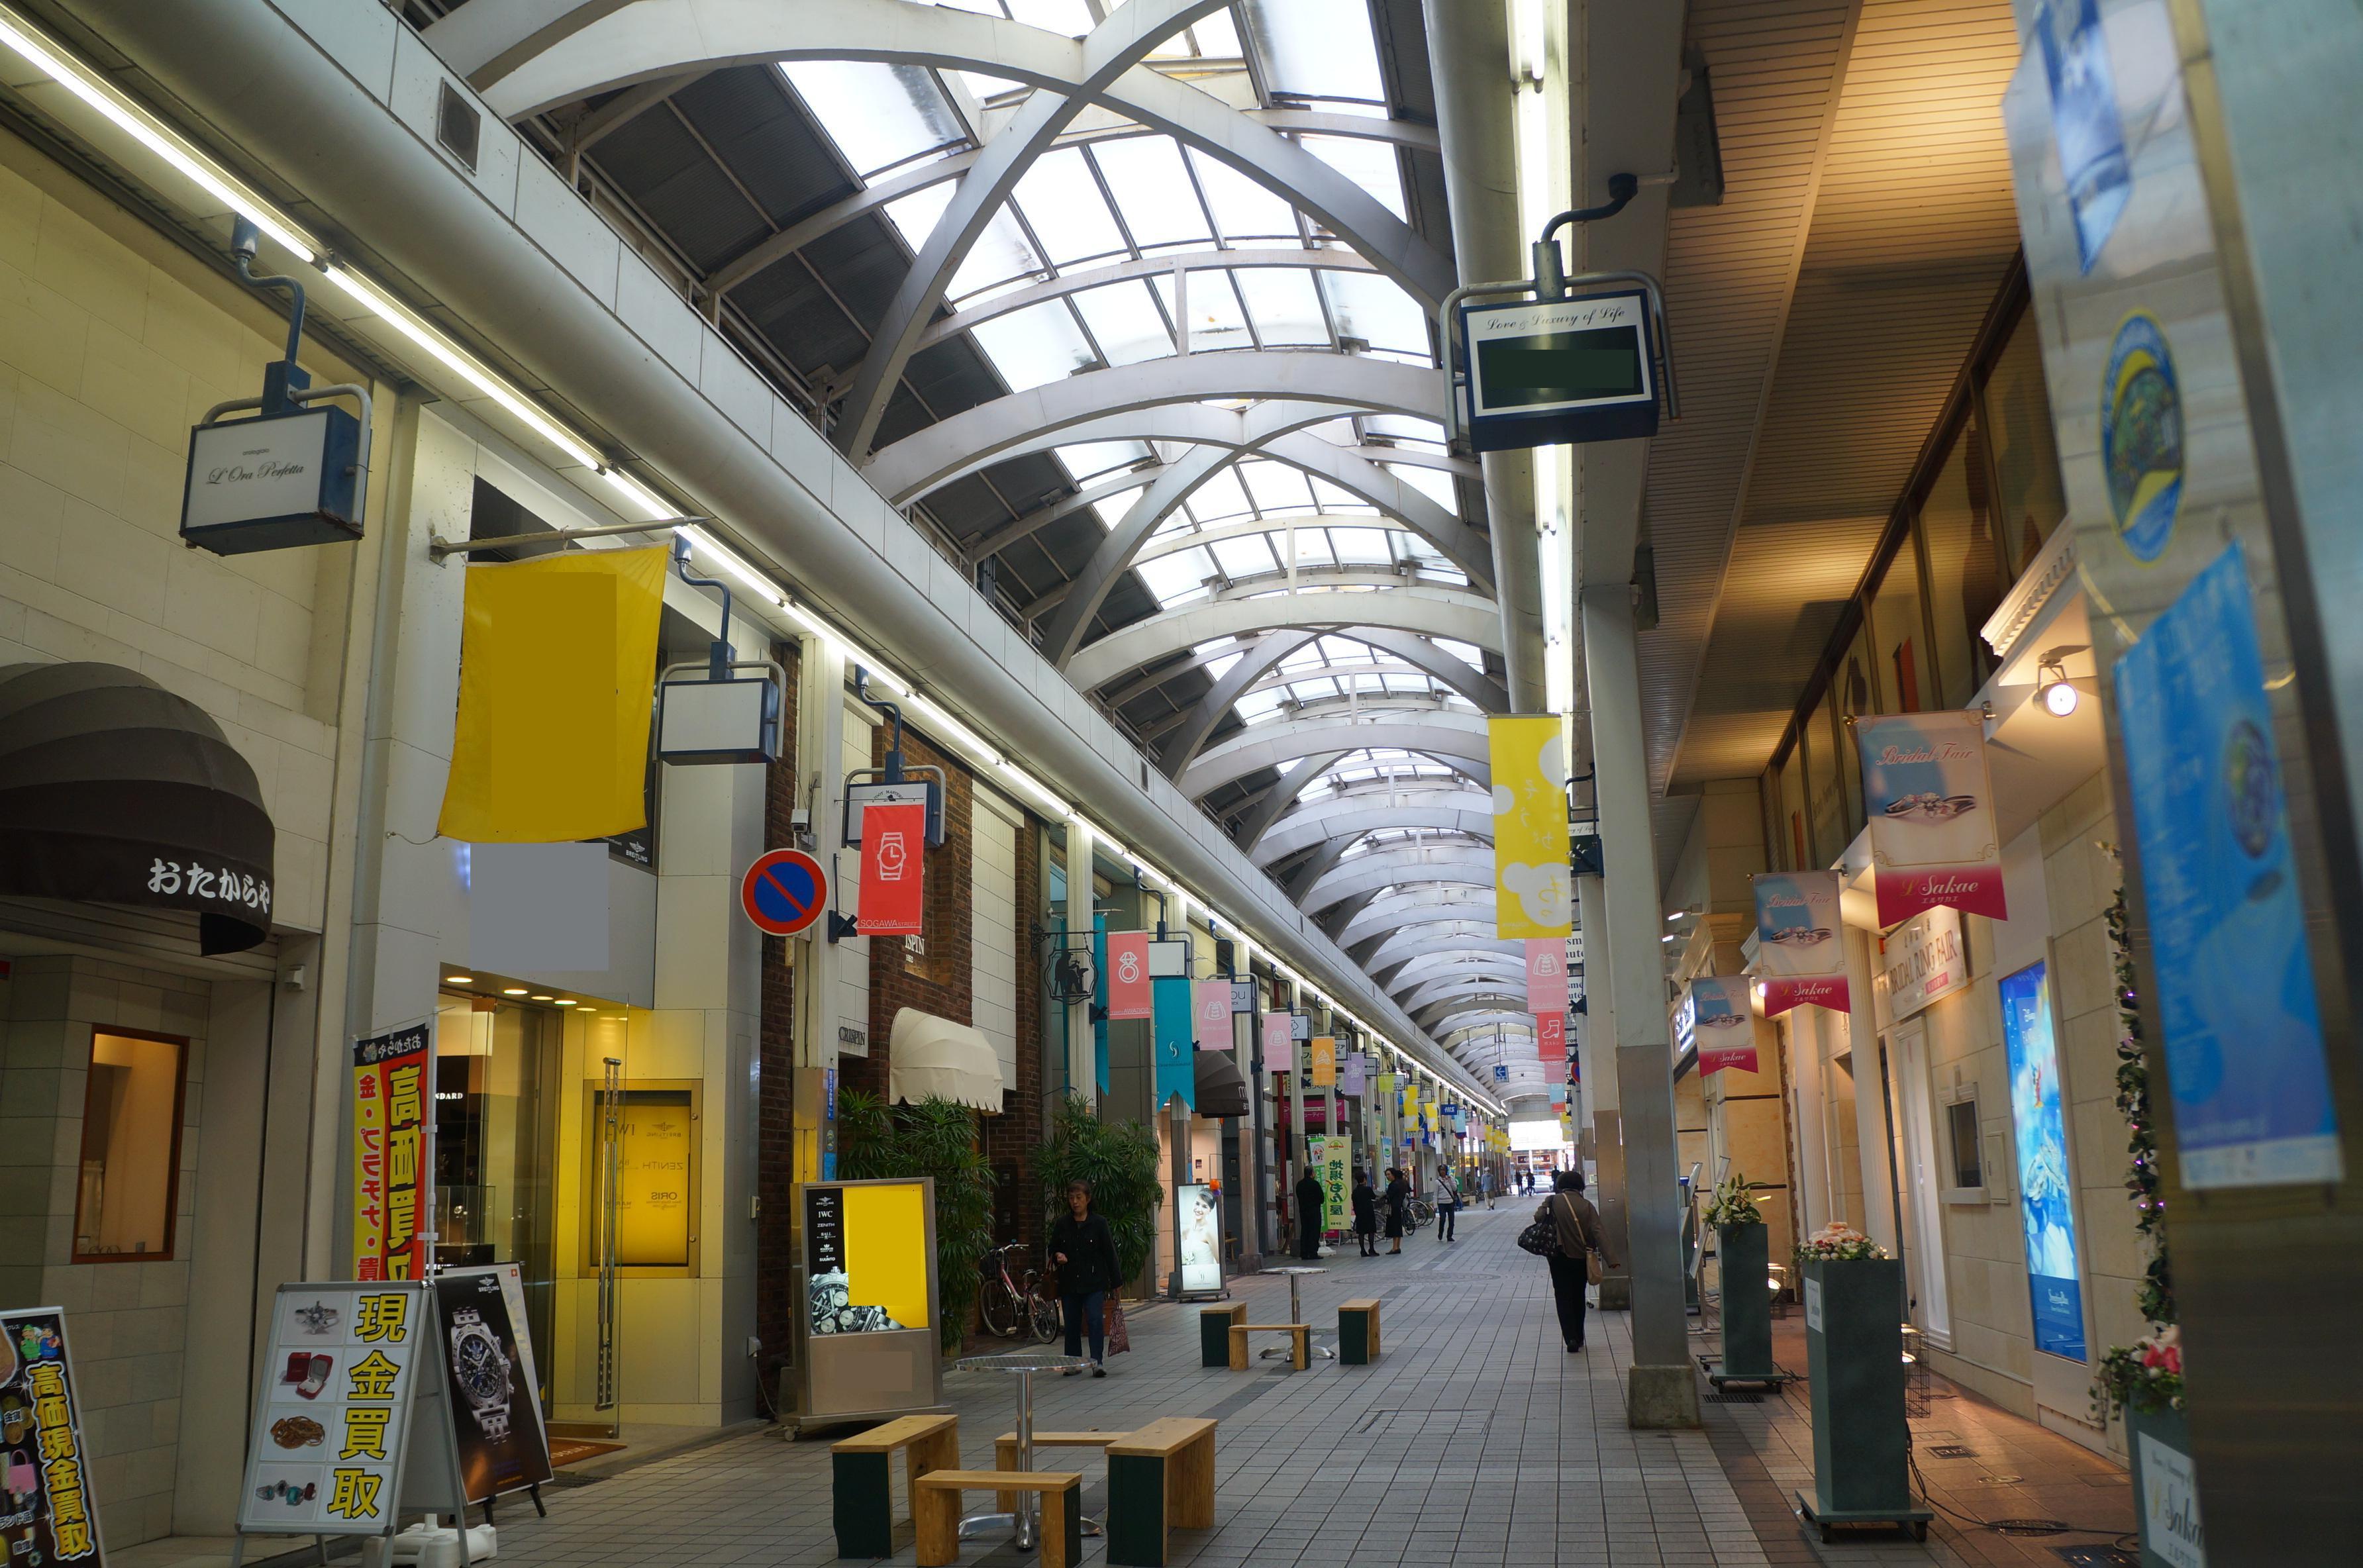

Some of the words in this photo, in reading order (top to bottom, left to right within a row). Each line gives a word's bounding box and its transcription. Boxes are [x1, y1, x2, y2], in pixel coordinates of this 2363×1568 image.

[1487, 318, 1516, 330] Love
[1531, 313, 1578, 327] Luxury
[1583, 309, 1596, 325] of
[1599, 306, 1625, 324] Life
[258, 461, 305, 482] Perfetta
[1876, 745, 1936, 765] Bridal
[1936, 742, 1974, 761] Fair
[626, 850, 648, 863] BREITLING
[148, 858, 270, 914] おたからや
[1920, 875, 1978, 896] Sakae
[1890, 957, 1914, 995] BRIDAL
[1914, 942, 1935, 980] RING
[1935, 930, 1958, 965] FAIR
[1793, 981, 1833, 996] Sakae
[838, 1026, 866, 1046] CRISPIN
[327, 1293, 408, 1519] 現金買取
[28, 1363, 91, 1556] 高価現金買取
